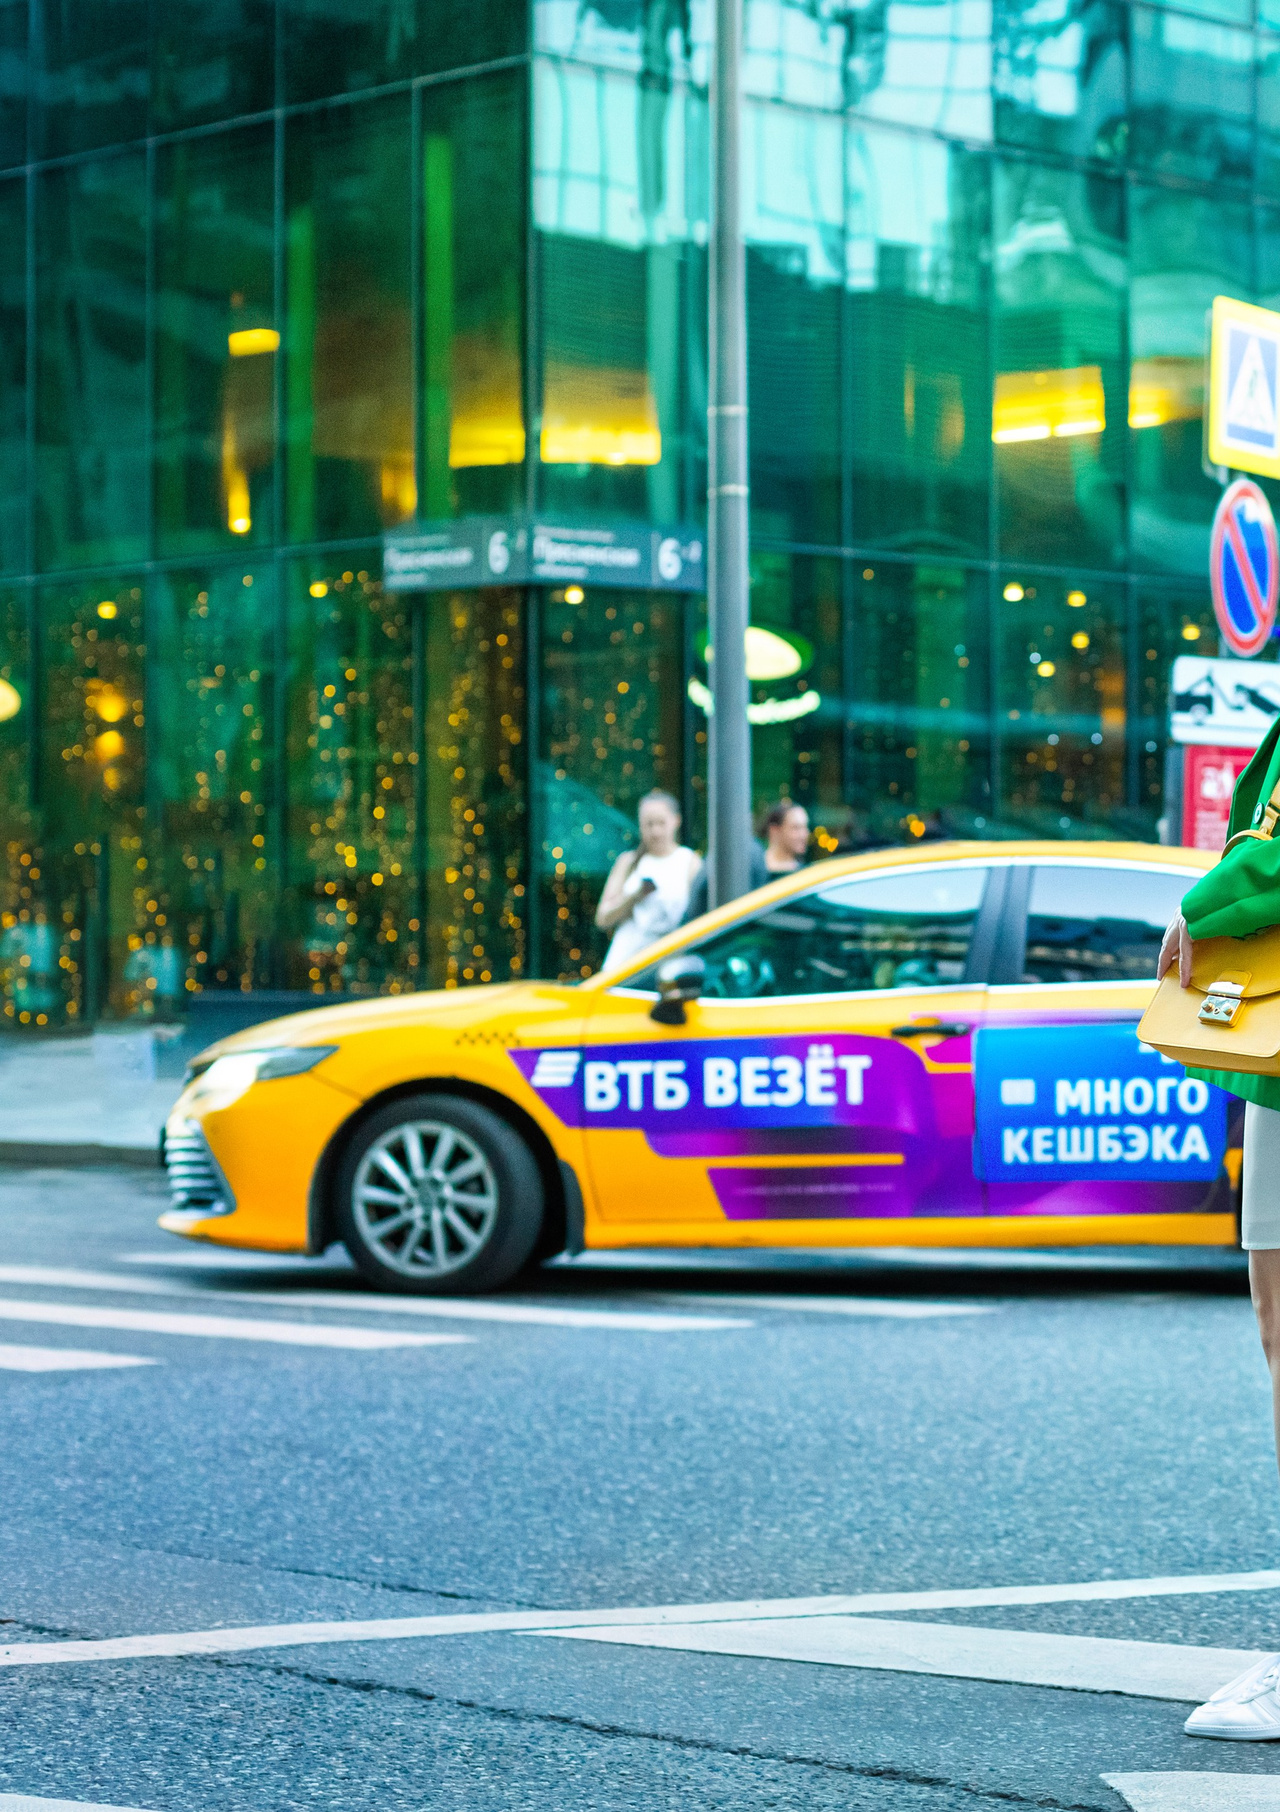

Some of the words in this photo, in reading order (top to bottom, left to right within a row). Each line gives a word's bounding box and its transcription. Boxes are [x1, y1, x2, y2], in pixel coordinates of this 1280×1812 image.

[583, 1059, 691, 1112] ВТБ
[702, 1043, 873, 1108] ВЕЗЁТ
[1054, 1077, 1210, 1117] МНОГО
[1002, 1124, 1211, 1164] КЕШБЭКА
